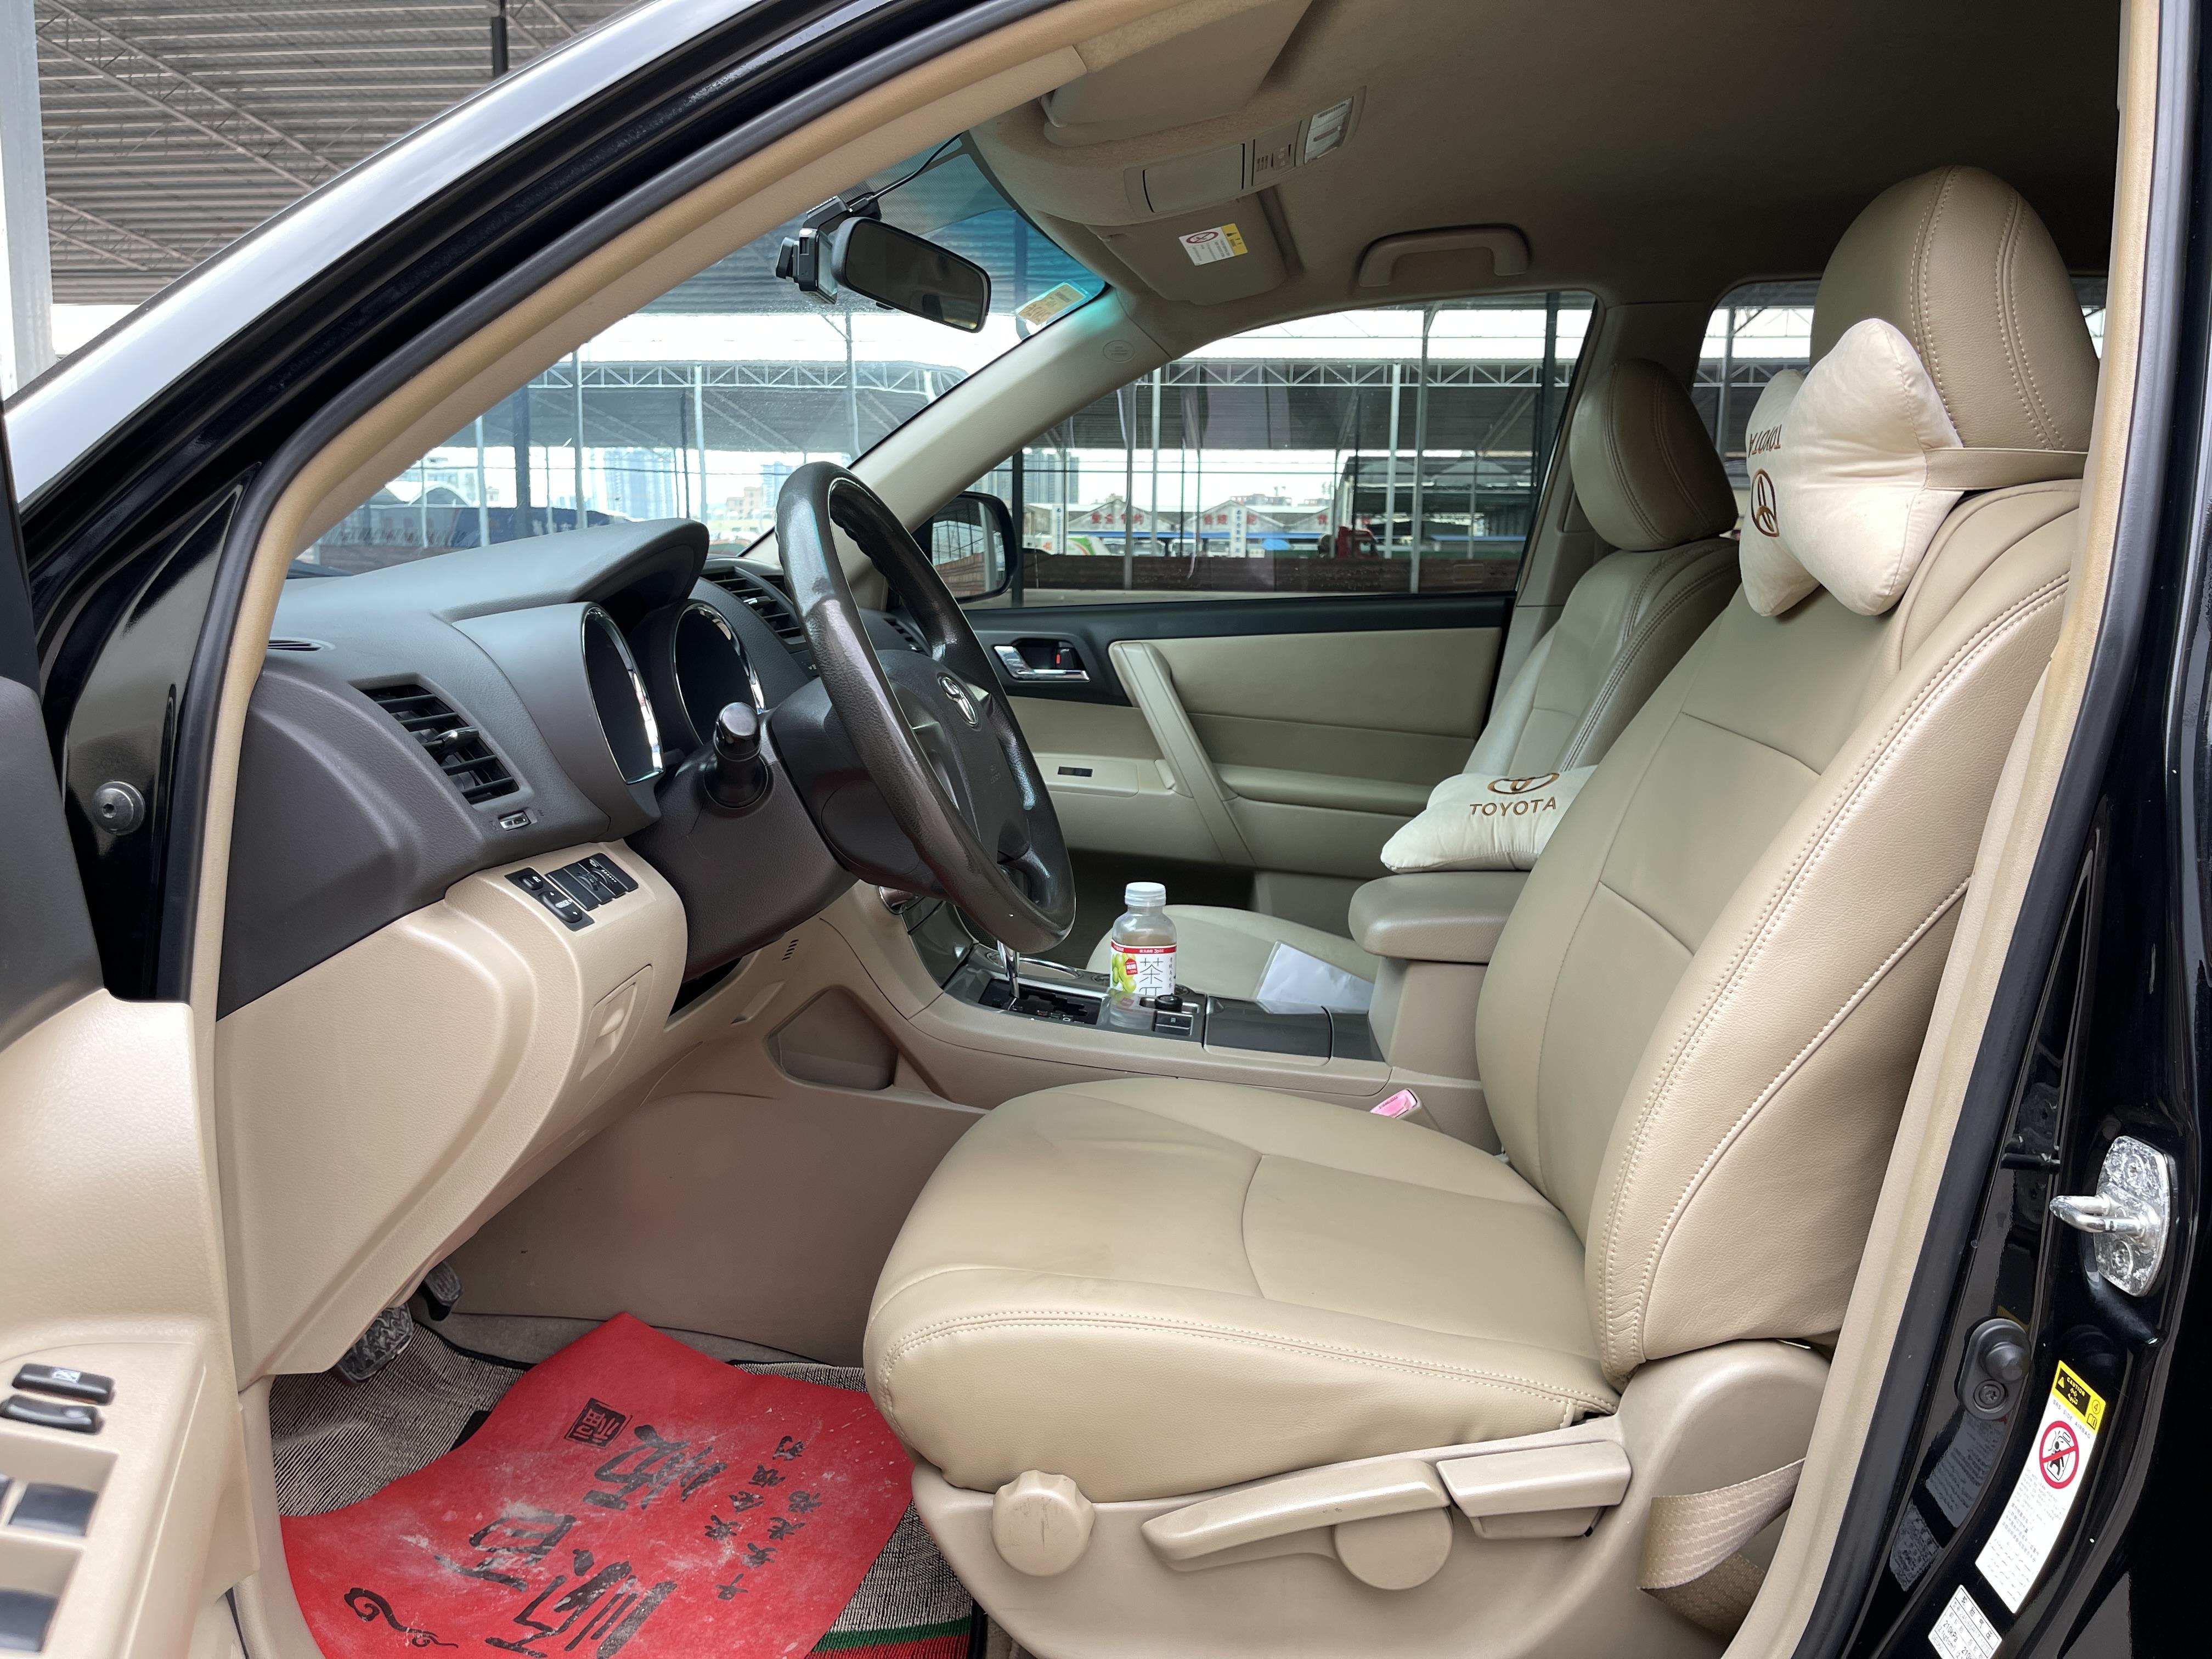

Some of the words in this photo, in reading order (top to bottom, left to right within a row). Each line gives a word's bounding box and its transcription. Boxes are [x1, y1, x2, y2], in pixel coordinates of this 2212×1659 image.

[1469, 796, 1557, 817] TOYOTA
[2067, 1376, 2085, 1397] CAUTION
[567, 1398, 627, 1447] 福
[2053, 1399, 2062, 1410] SRS
[2063, 1409, 2073, 1421] SIDE
[2075, 1421, 2091, 1439] AIRBAG
